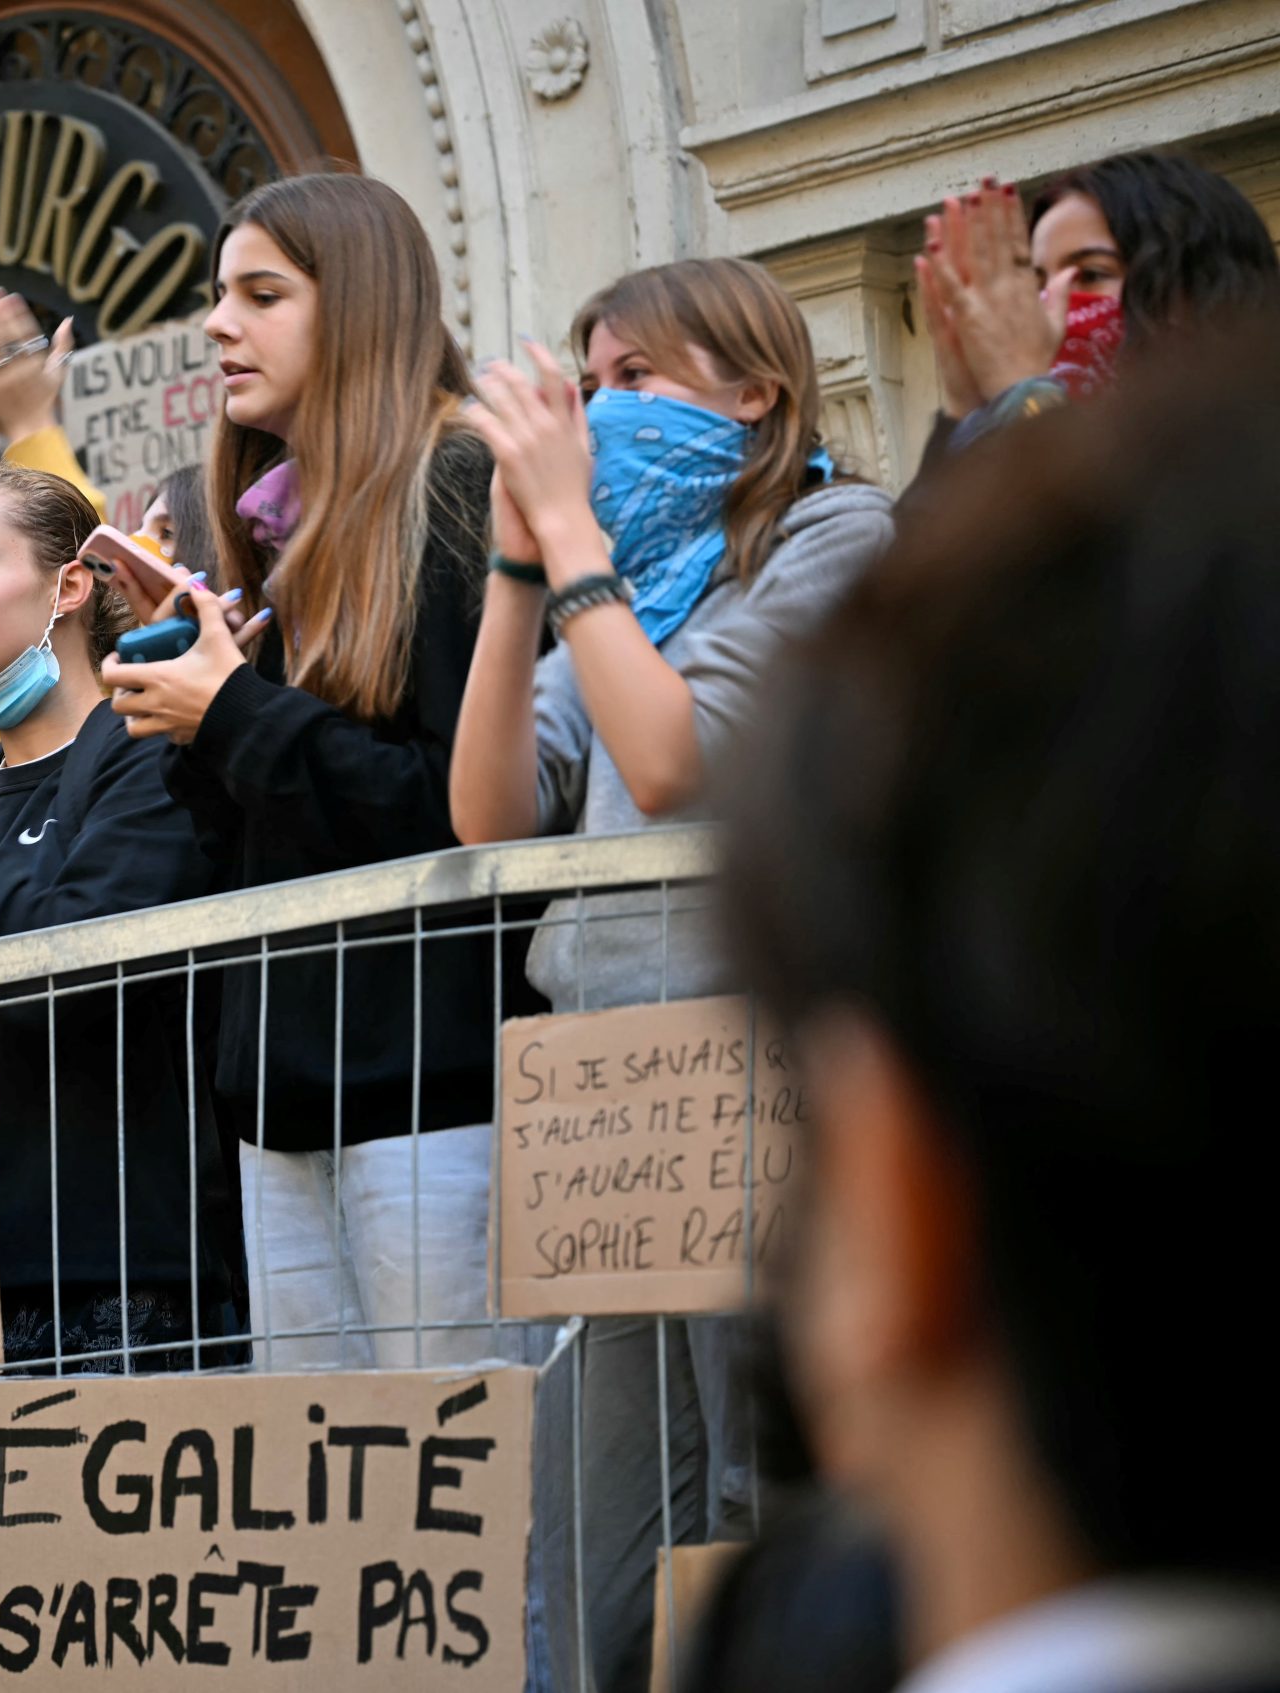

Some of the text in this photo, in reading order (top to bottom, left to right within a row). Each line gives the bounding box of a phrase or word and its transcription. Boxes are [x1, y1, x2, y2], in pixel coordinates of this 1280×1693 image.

[574, 1057, 609, 1090] JE
[648, 1094, 699, 1134] ME
[530, 1215, 656, 1279] SOPHIE
[356, 1560, 490, 1669] PAS
